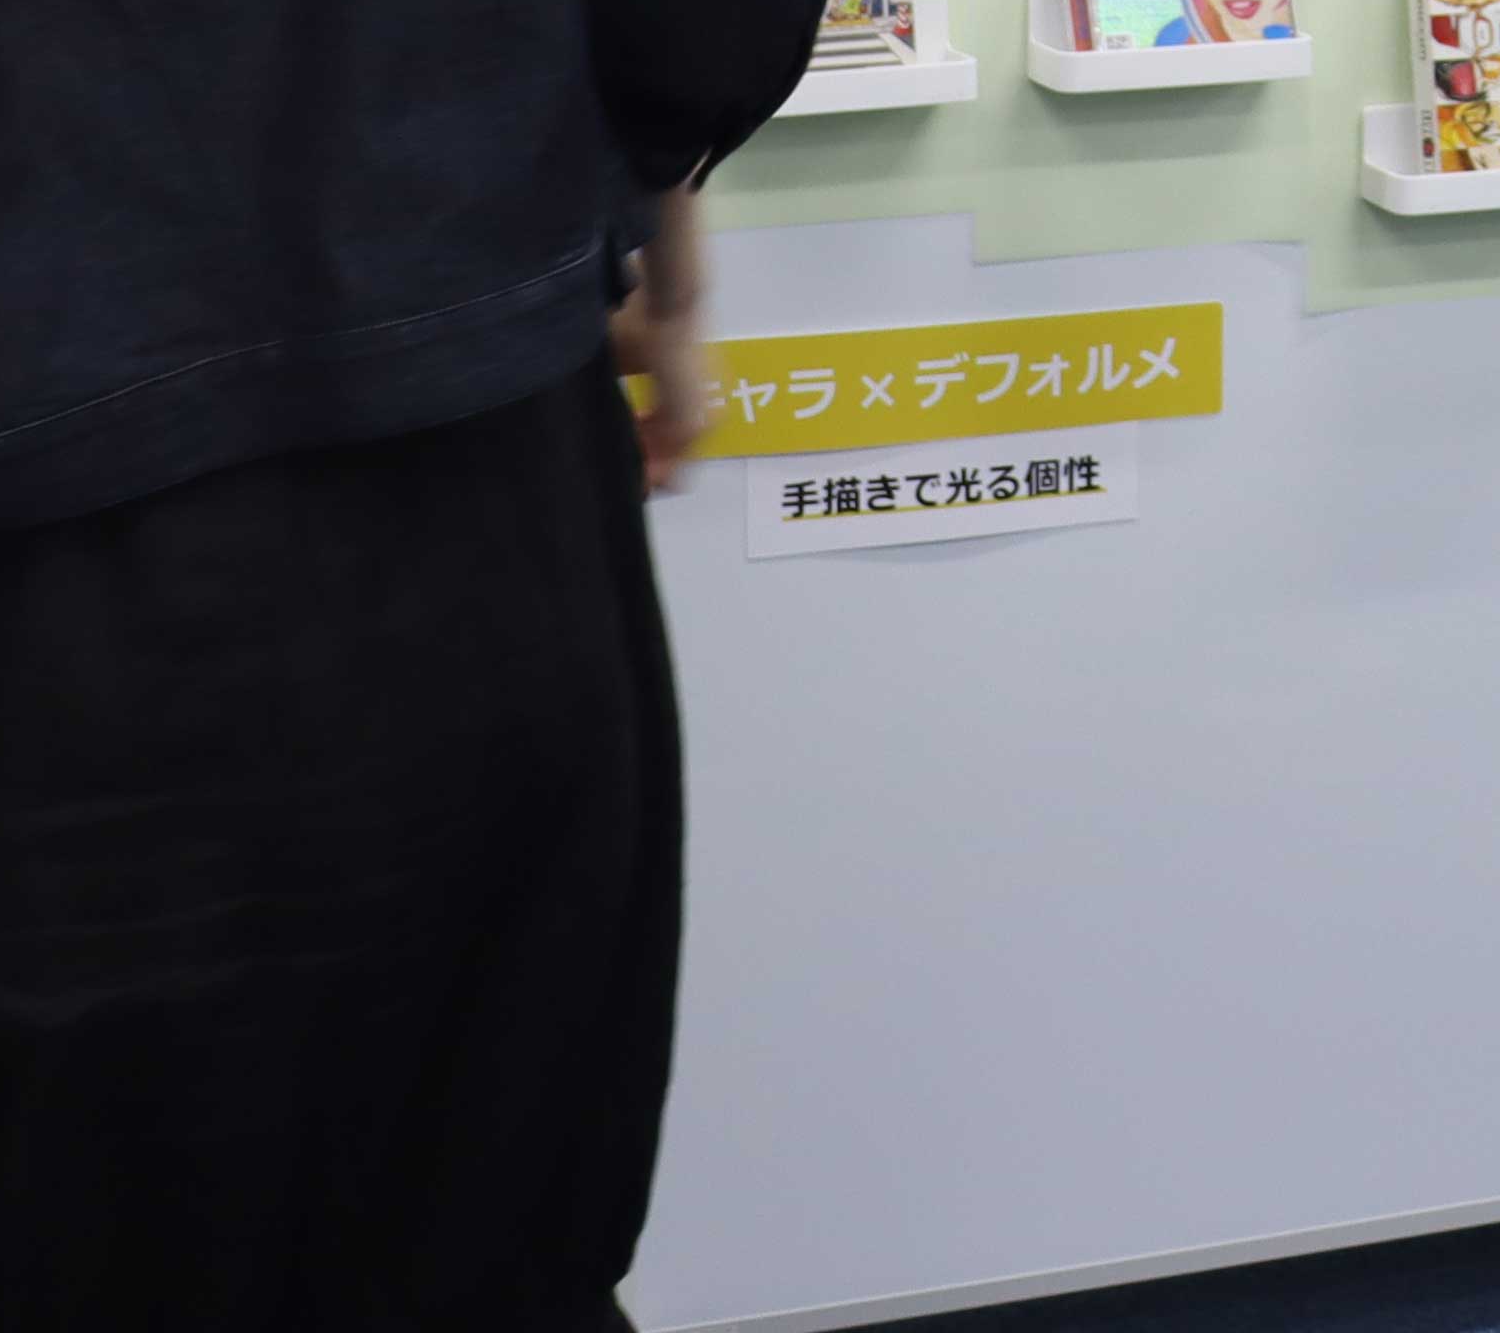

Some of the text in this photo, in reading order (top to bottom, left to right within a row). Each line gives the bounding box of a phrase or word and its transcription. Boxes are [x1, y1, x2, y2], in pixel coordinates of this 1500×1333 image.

[912, 336, 1179, 410] デフォルメ
[781, 454, 1102, 519] 手描きで光る個性
